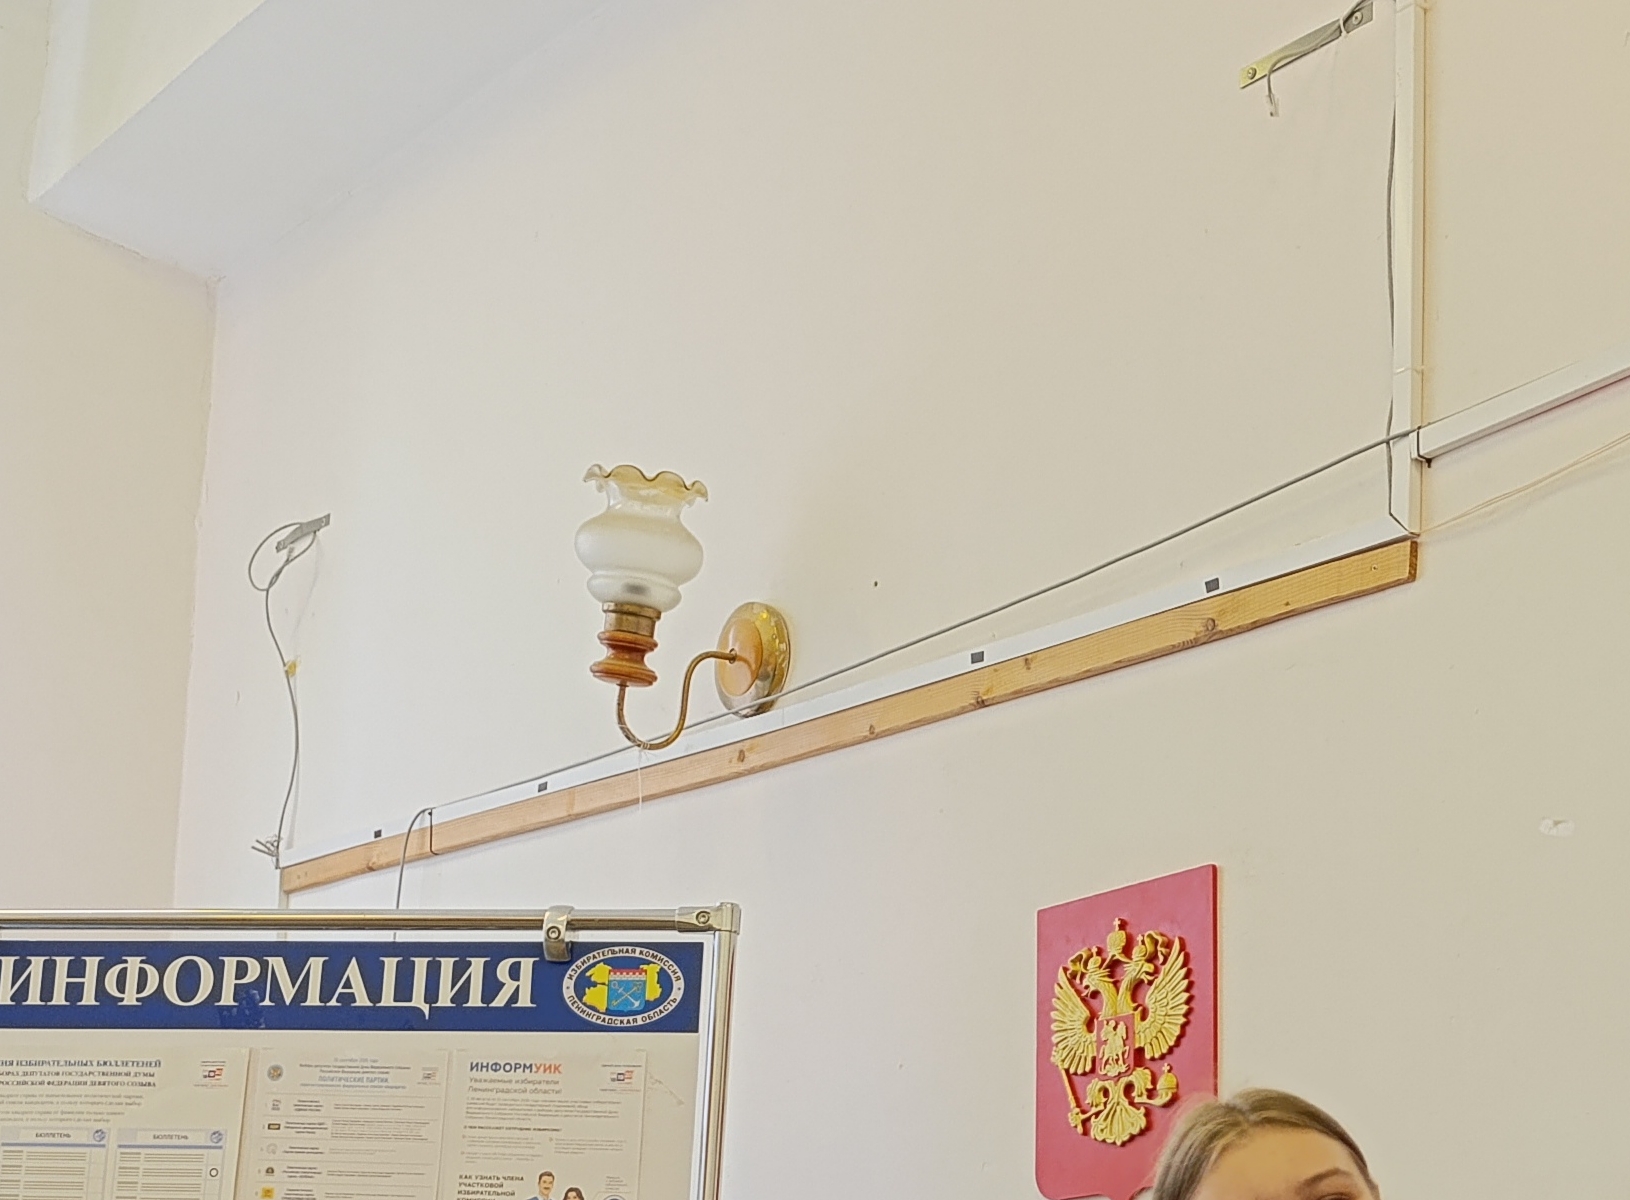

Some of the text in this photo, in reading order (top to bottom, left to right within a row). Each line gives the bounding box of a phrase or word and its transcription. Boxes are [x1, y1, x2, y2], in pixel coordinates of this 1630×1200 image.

[568, 947, 682, 982] ИЗБИРАТЕЛЬНАЯ КОМИССИЯ
[0, 955, 540, 1020] ИНФОРМАЦИЯ
[567, 995, 678, 1025] ЛЕНИНГРАДСКАЯ ОБЛАСТЬ
[469, 1061, 563, 1075] ИНФОРМУИК
